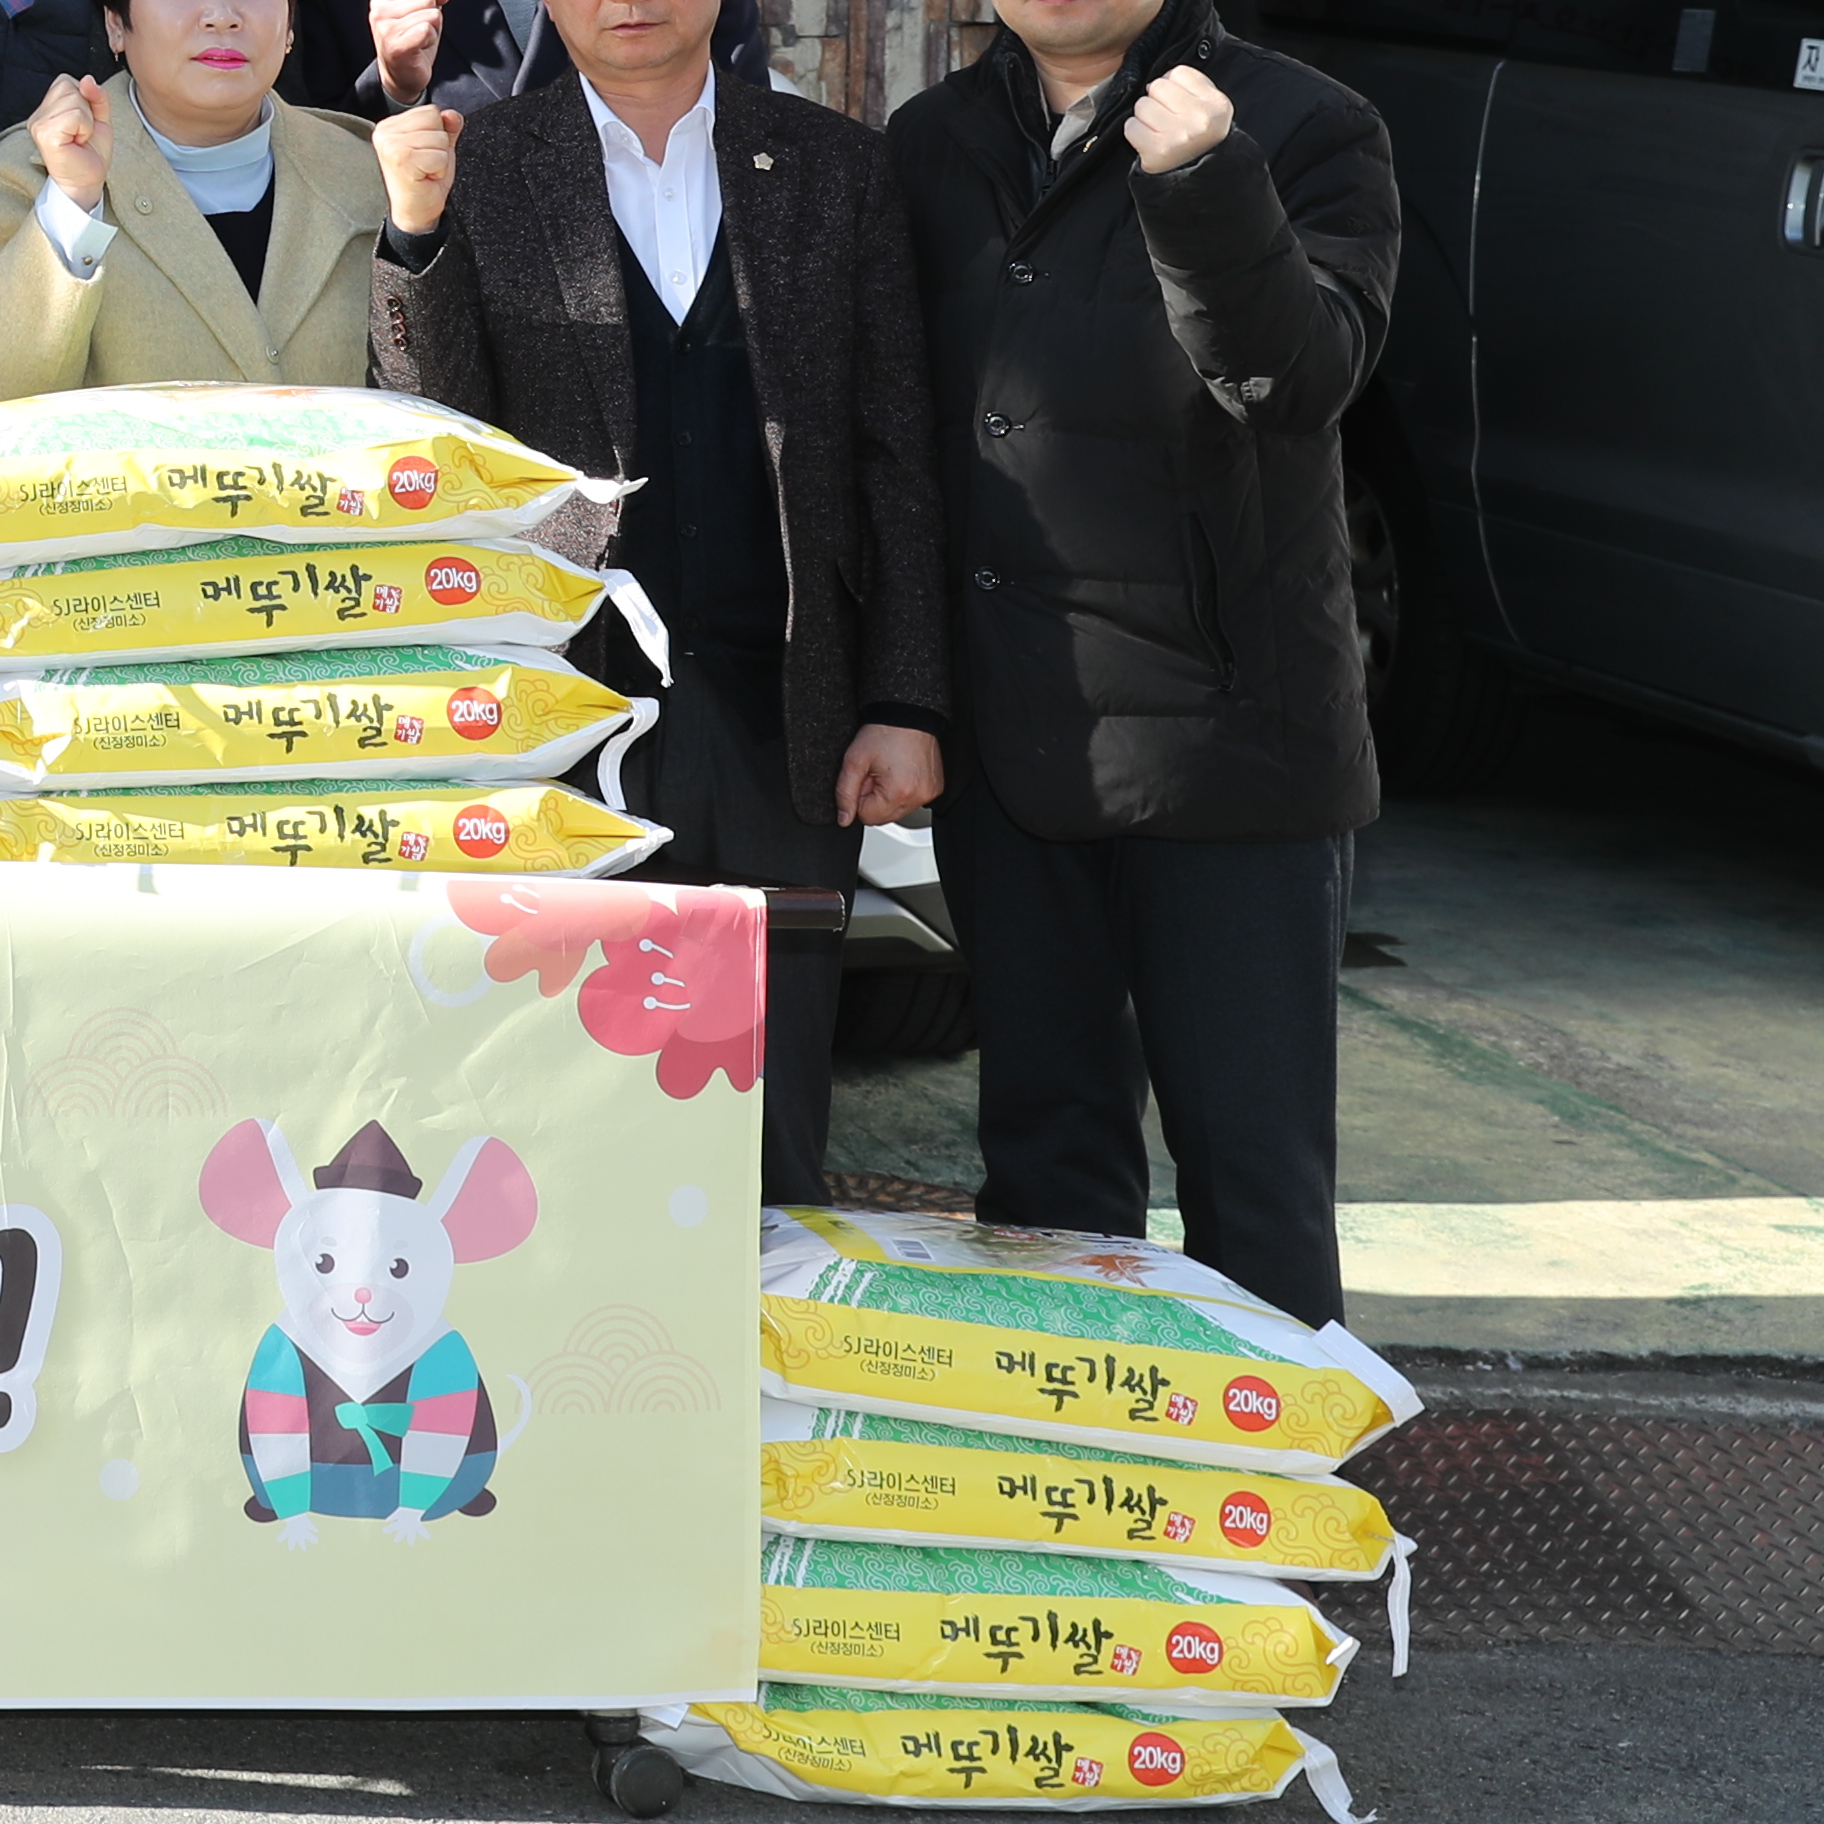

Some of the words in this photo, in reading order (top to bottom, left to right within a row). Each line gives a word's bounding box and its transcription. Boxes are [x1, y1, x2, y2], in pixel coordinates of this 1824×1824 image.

[20, 477, 127, 502] SJ라이스센터
[167, 463, 335, 519] 메뚜기쌀
[393, 469, 436, 494] 20kg
[430, 568, 477, 593] 20kg
[53, 591, 160, 616] SJ라이스센터
[201, 563, 372, 628] 메뚜기쌀
[74, 712, 180, 735] SJ라이스센터
[223, 693, 393, 754] 메뚜기쌀
[451, 700, 498, 725] 20kg
[75, 822, 184, 841] SJ라이스센터
[226, 805, 399, 866] 메뚜기쌀
[459, 818, 504, 843] 20kg
[844, 1336, 953, 1367] SJ라이스센터
[995, 1351, 1170, 1422] 메뚜기쌀
[1228, 1388, 1277, 1418] 20kg
[847, 1469, 956, 1496] SJ라이스센터
[998, 1475, 1168, 1542] 메뚜기쌀
[1225, 1505, 1268, 1533] 20kg
[794, 1618, 900, 1642] SJ라이스센터
[940, 1610, 1114, 1676] 메뚜기쌀
[1171, 1636, 1219, 1663] 20kg
[901, 1724, 1074, 1789] 메뚜기쌀
[1133, 1747, 1181, 1774] 20kg
